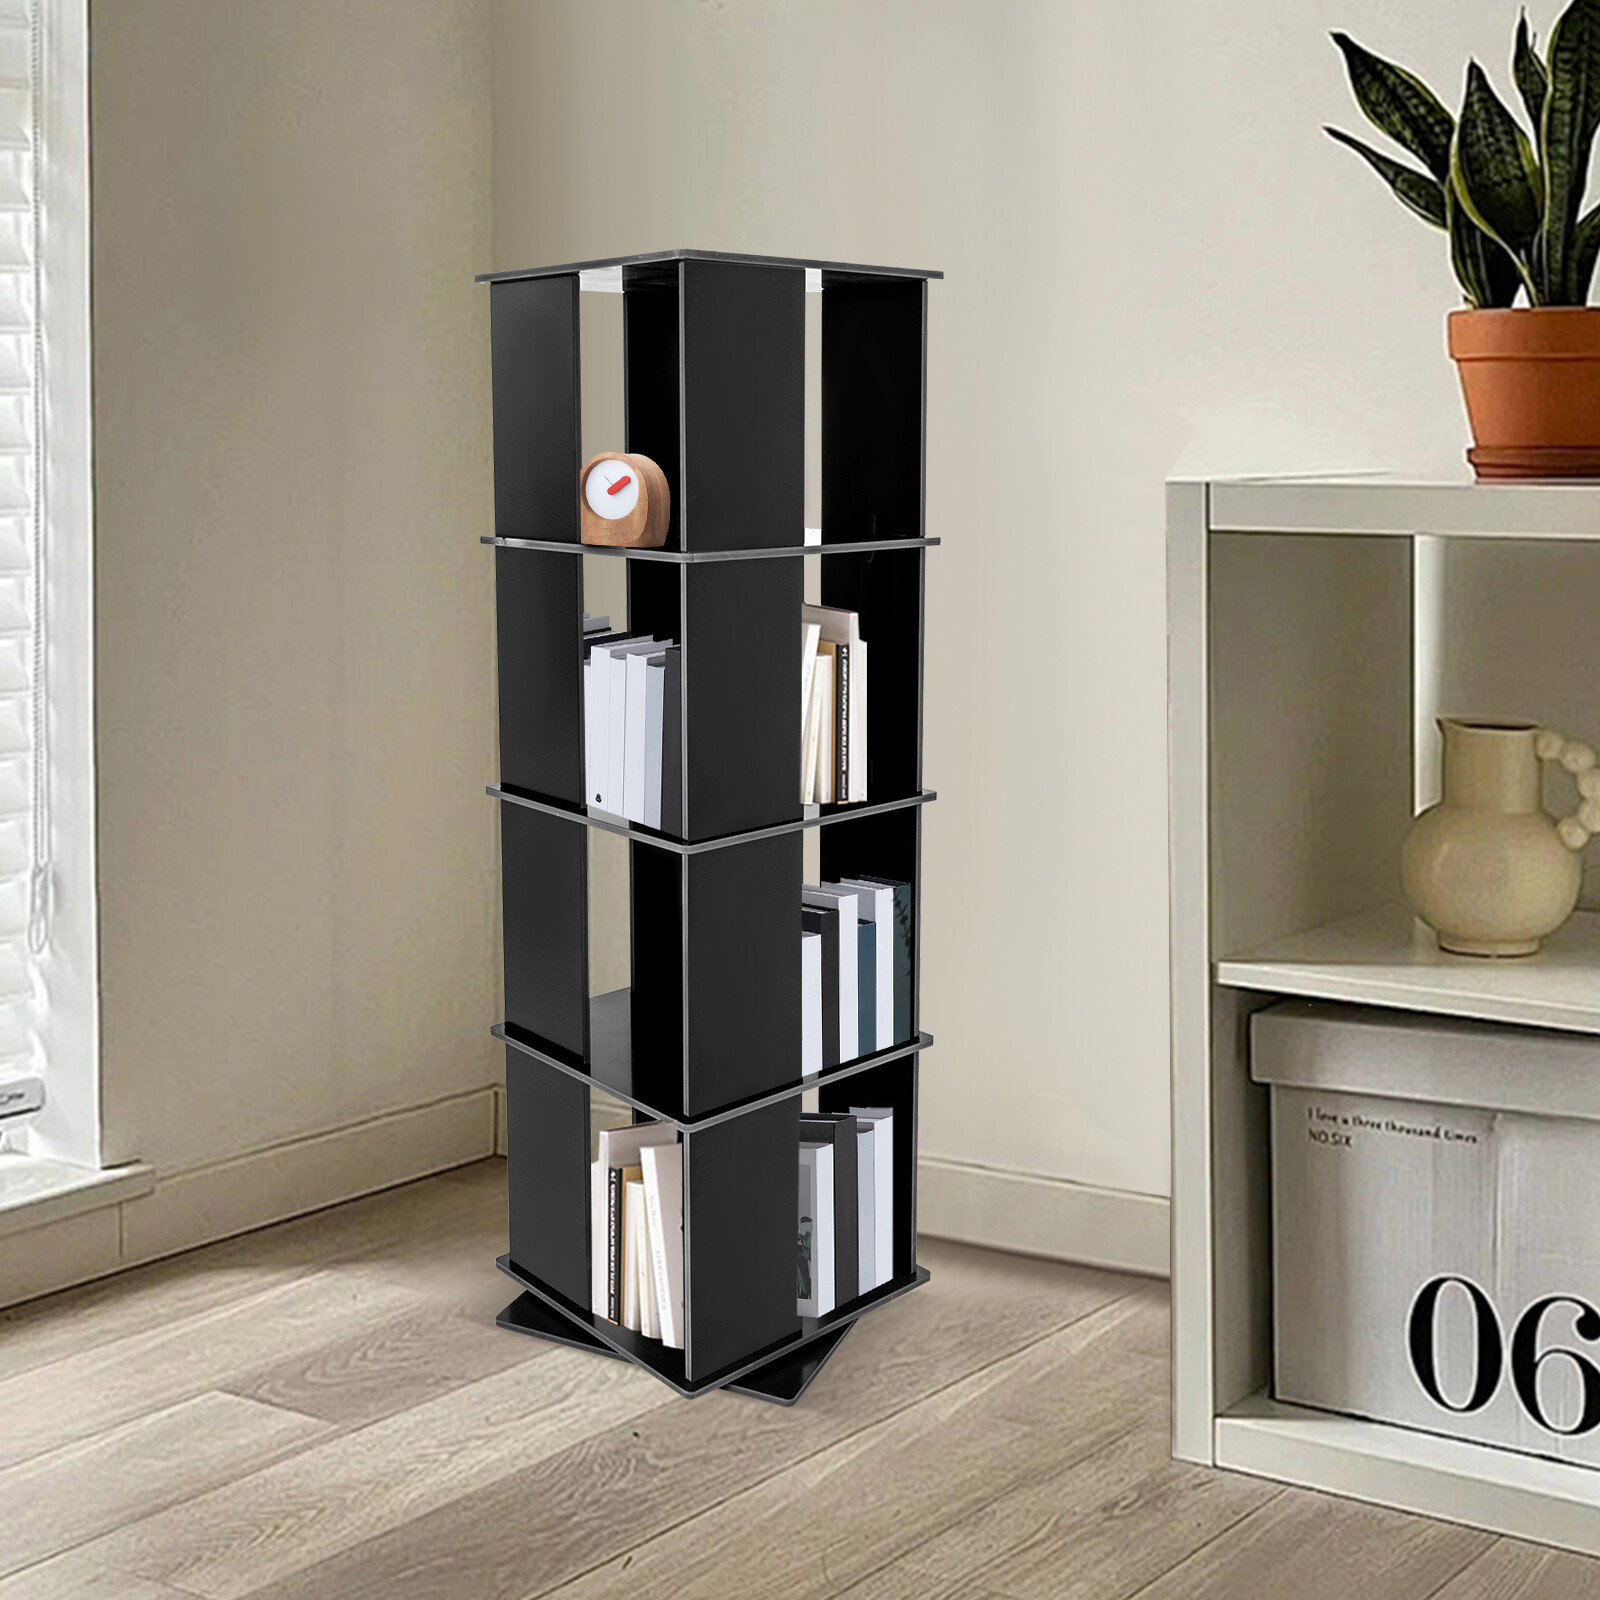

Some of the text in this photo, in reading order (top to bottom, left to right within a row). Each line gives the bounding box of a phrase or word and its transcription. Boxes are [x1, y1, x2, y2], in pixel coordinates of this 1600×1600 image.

[1352, 1115, 1381, 1130] three
[1385, 1120, 1441, 1139] thousand
[1408, 1276, 1600, 1436] 06
